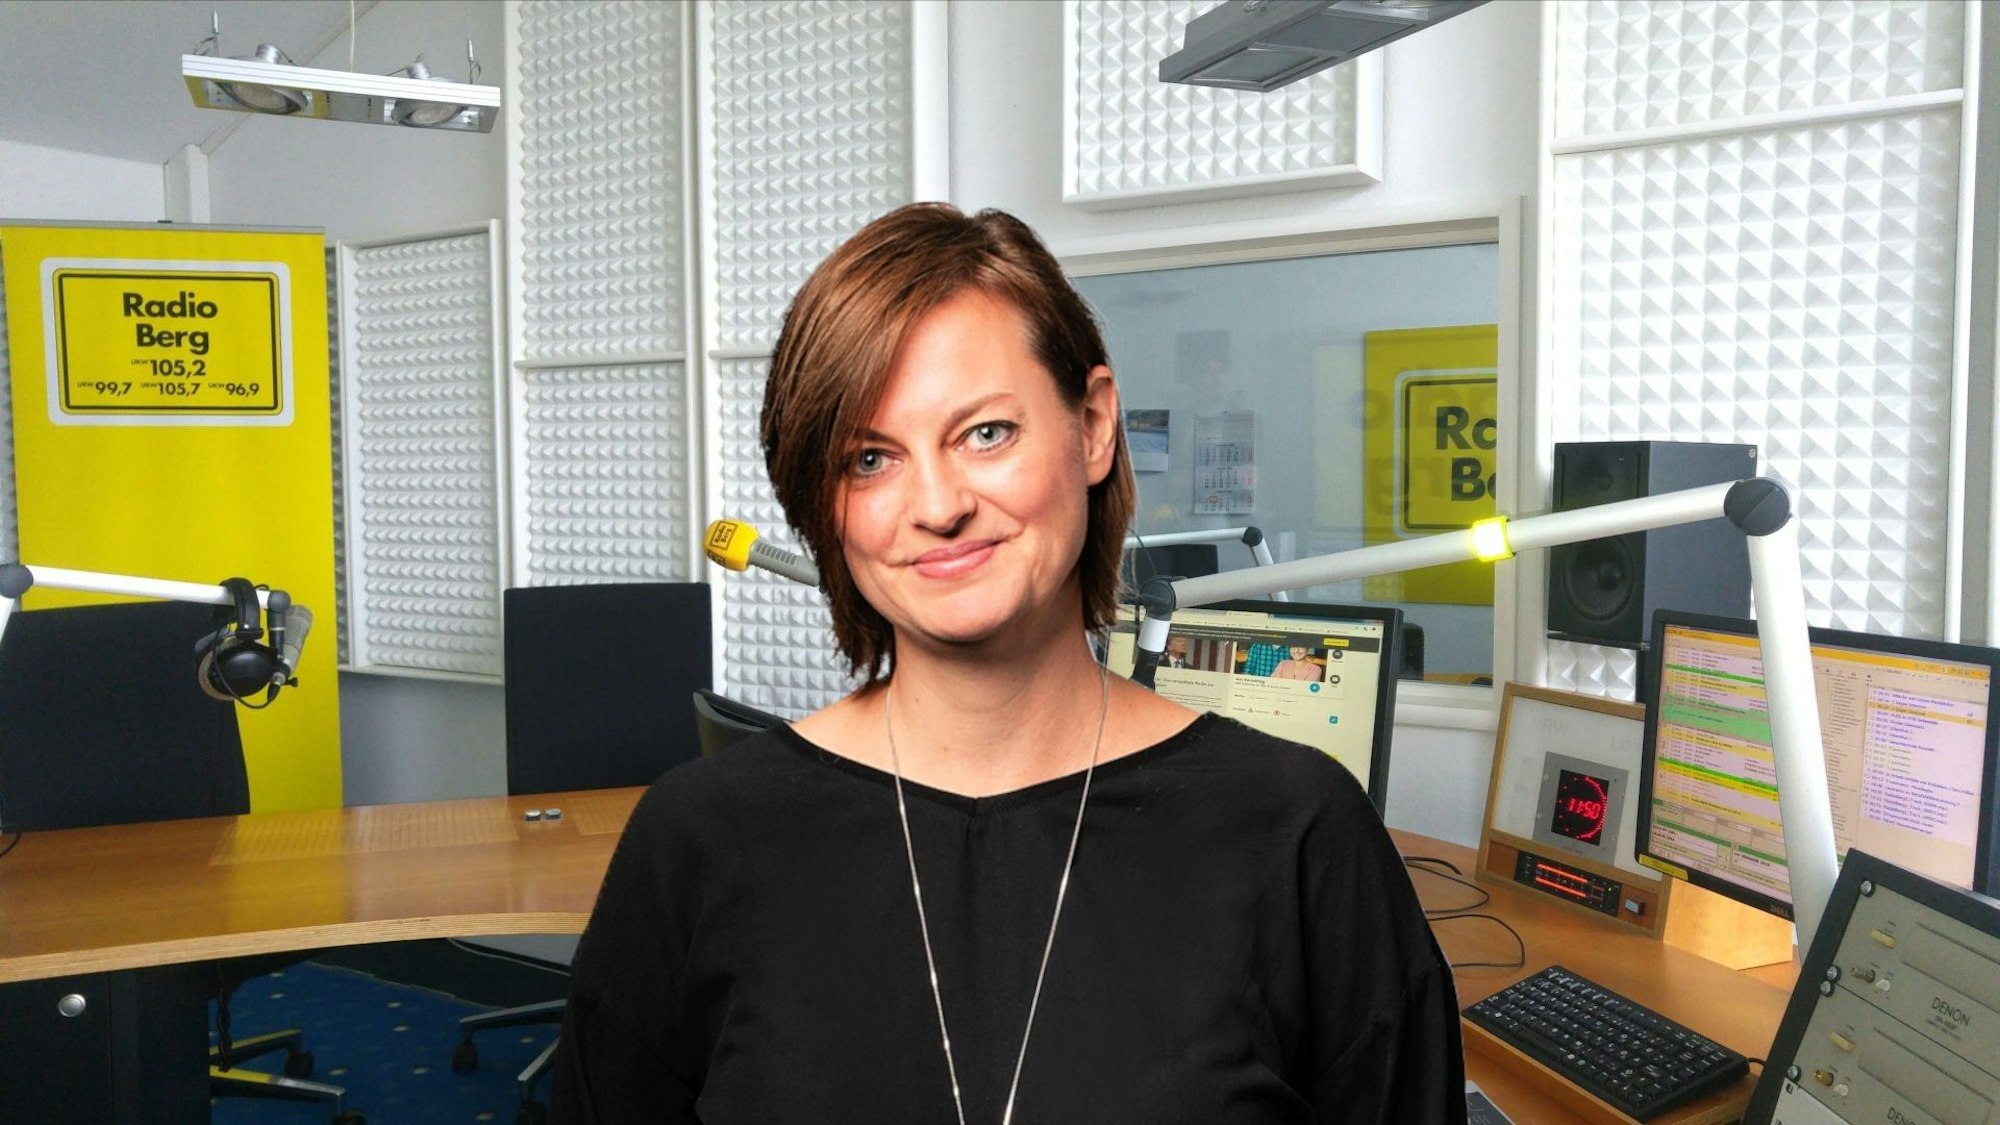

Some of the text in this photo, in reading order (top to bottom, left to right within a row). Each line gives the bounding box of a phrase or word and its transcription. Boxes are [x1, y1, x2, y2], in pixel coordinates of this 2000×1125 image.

[122, 291, 218, 319] Radio
[136, 323, 209, 355] Berg
[150, 359, 206, 379] 105,2
[95, 381, 132, 397] 99,7
[158, 382, 201, 397] 105,7
[225, 383, 260, 397] 96,9
[1451, 457, 1497, 501] B
[1567, 797, 1601, 820] 11:50
[1931, 996, 1970, 1026] DENON
